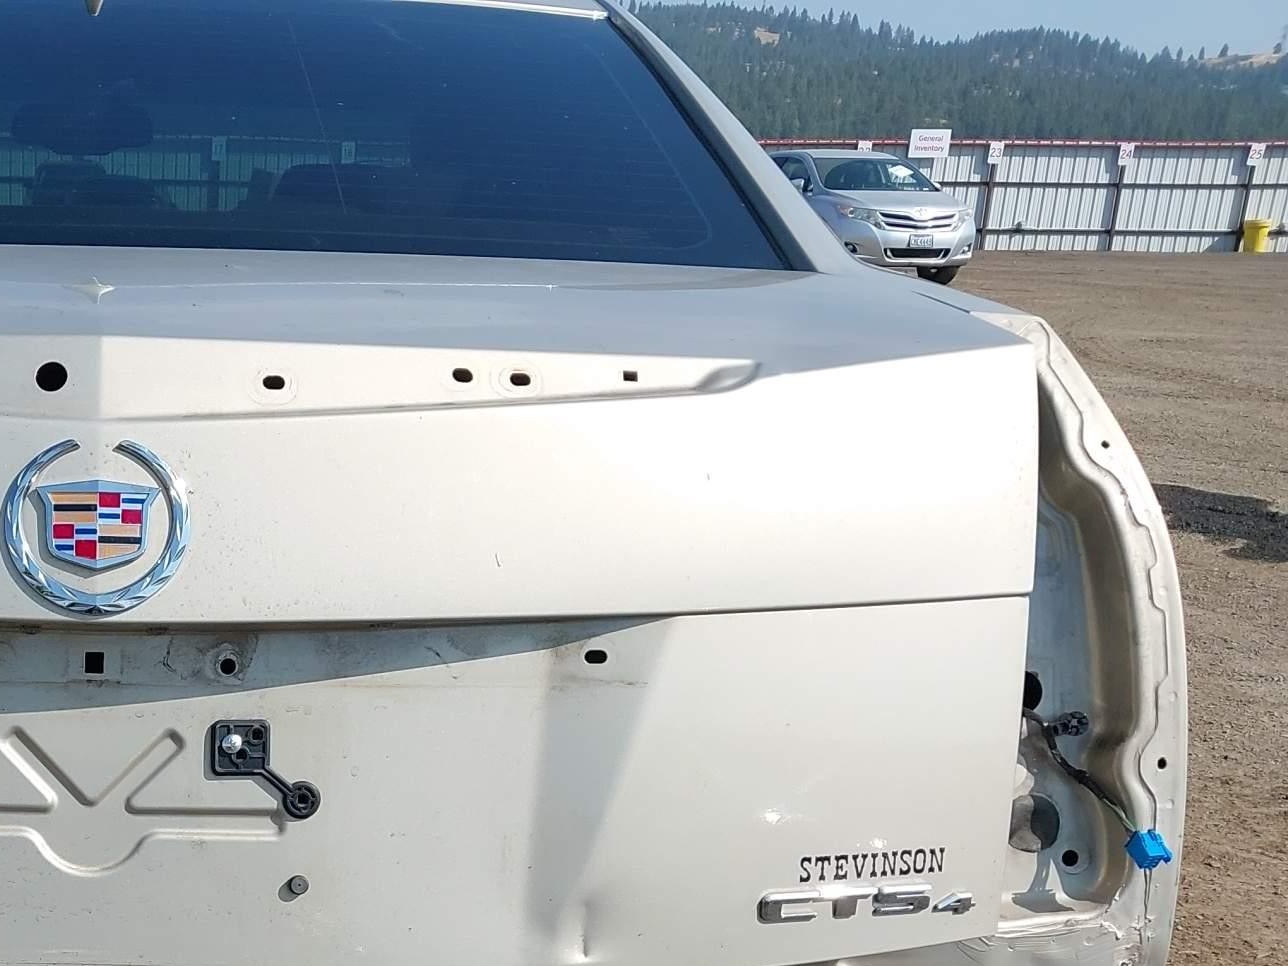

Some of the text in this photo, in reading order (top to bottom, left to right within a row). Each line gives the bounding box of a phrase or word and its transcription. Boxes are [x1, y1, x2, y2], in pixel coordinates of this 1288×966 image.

[991, 147, 1002, 158] 23
[1120, 149, 1132, 159] 24
[1250, 149, 1263, 160] 25
[799, 847, 946, 883] STEVINSON
